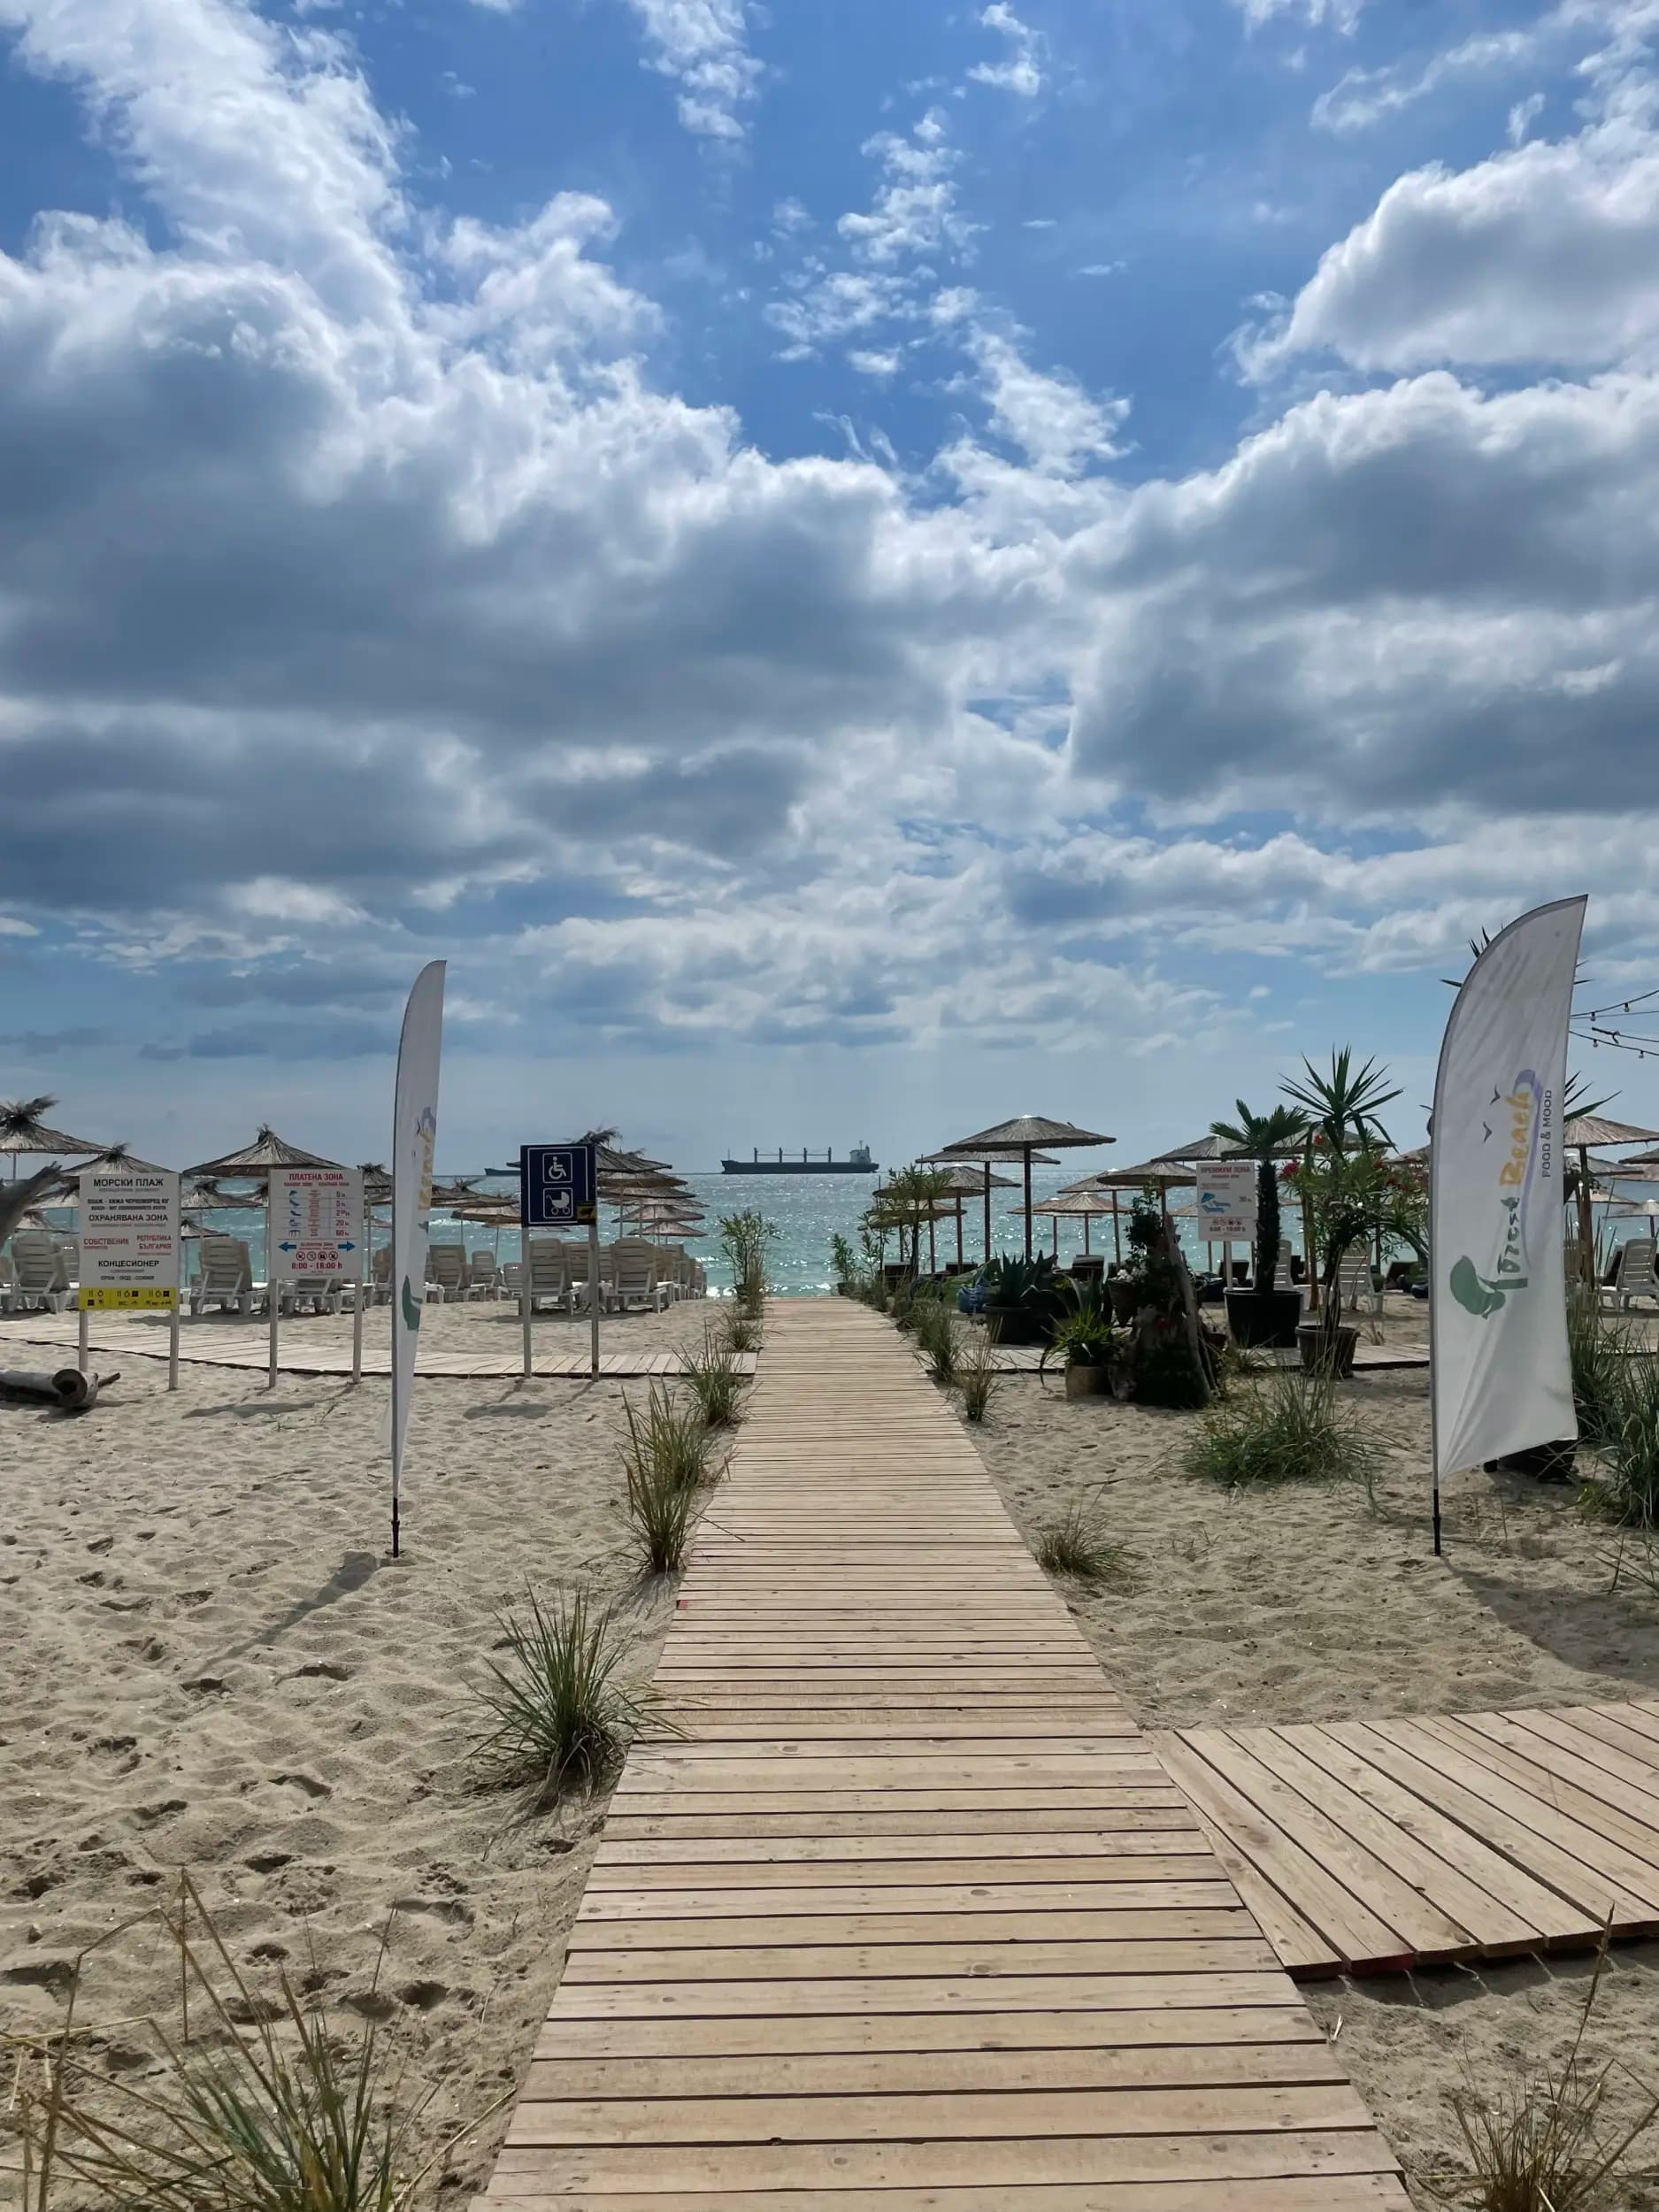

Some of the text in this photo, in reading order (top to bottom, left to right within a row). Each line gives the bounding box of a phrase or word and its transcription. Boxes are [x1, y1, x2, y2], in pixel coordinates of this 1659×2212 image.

[1500, 1092, 1531, 1187] Beach
[1540, 1090, 1553, 1179] FOOD & MOOD
